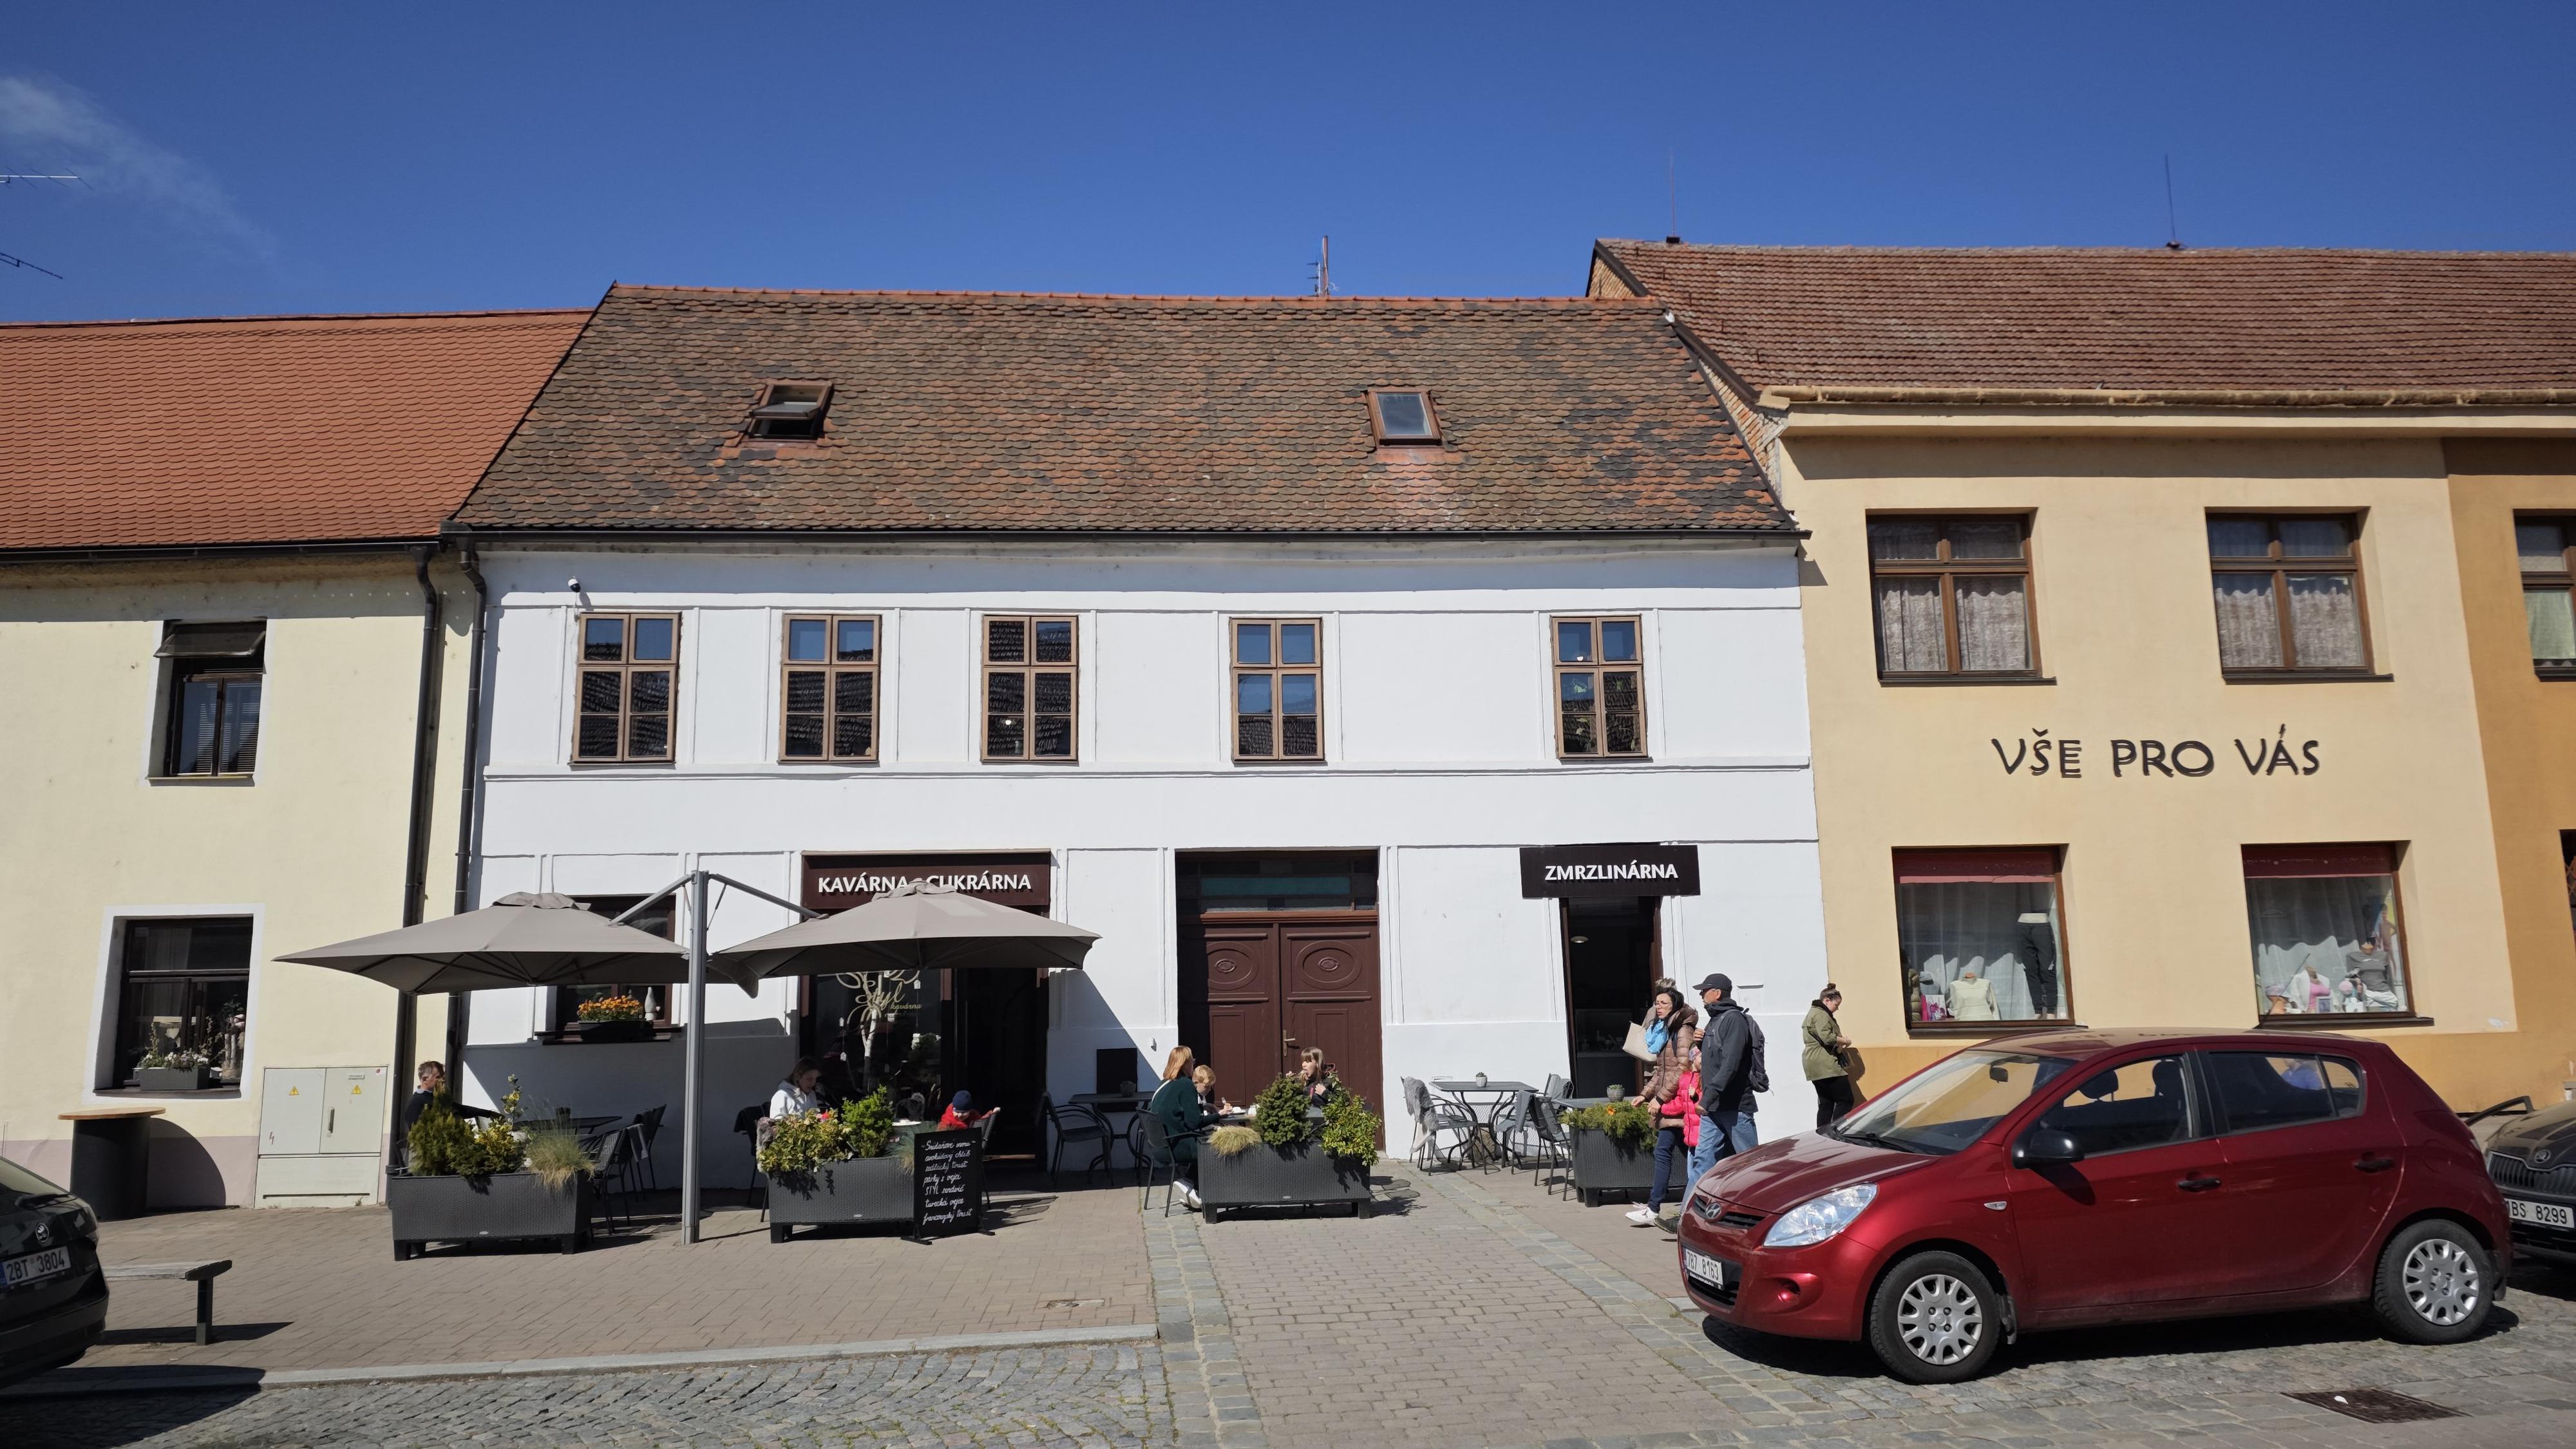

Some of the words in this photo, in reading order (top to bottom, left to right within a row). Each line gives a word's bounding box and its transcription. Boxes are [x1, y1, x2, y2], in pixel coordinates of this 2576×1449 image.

[1991, 727, 2082, 778] VŠE
[2110, 739, 2214, 777] PRO
[2233, 723, 2320, 776] VÁS
[1544, 860, 1678, 880] ZMRZLINÁRNA
[818, 872, 909, 893] KAVÁRNA
[890, 1001, 923, 1010] kavárna
[925, 1186, 939, 1196] STYL
[956, 1208, 974, 1217] toust
[2535, 1205, 2568, 1225] 8299
[6, 1258, 28, 1282] 2BT
[37, 1250, 65, 1273] 3804
[1702, 1258, 1719, 1281] 8163
